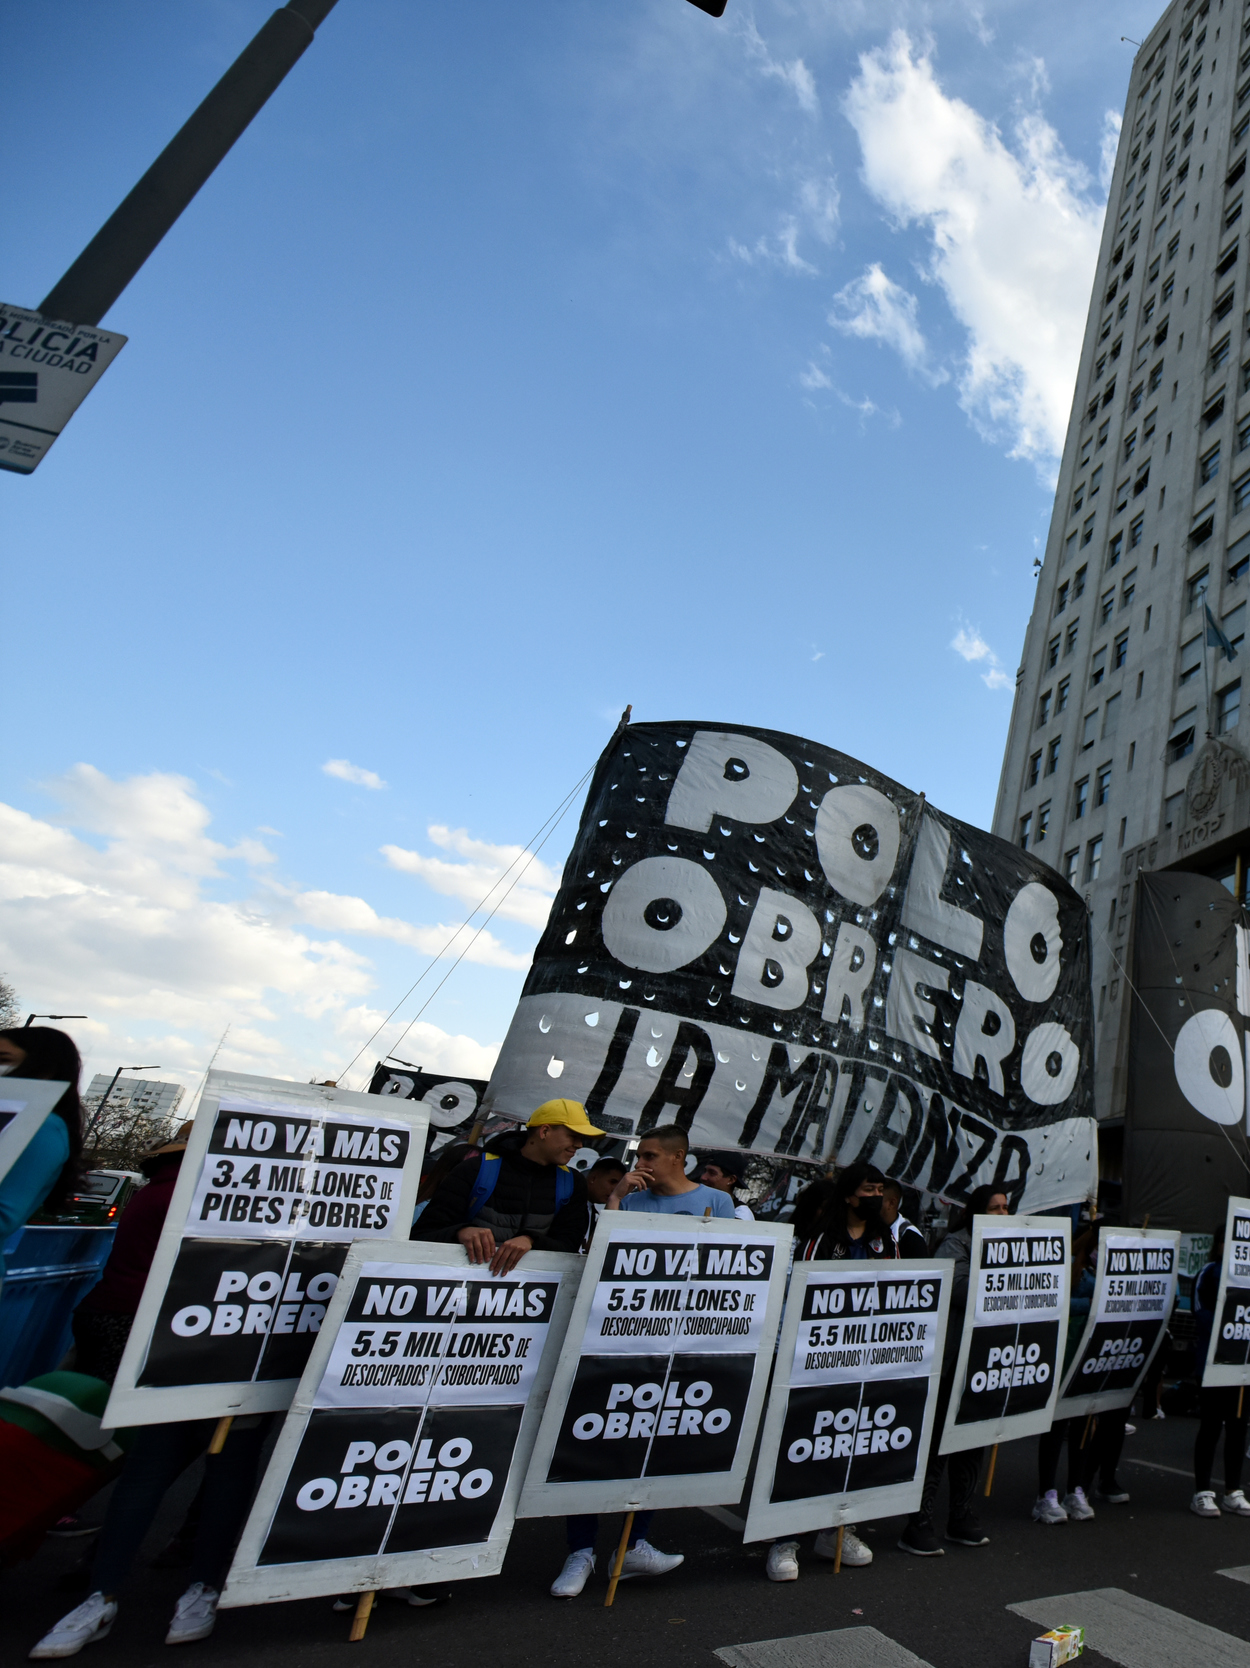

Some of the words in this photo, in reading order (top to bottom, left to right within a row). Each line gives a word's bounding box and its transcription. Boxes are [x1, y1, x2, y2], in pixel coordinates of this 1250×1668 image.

[78, 330, 97, 340] POR
[99, 336, 111, 344] LA
[10, 343, 93, 375] CIUDAD
[664, 731, 1062, 1002] POLO
[601, 856, 1080, 1105] OBRERO
[587, 1007, 716, 1136] LA
[738, 1043, 1030, 1214] MATANZA
[223, 1118, 277, 1152] NO
[285, 1124, 325, 1157] VA
[332, 1126, 401, 1162] MÁS
[211, 1160, 261, 1190] 3.4
[267, 1165, 378, 1200] MILLONES
[380, 1181, 395, 1201] DE
[200, 1192, 284, 1224] PIBES
[288, 1198, 391, 1230] POBRES
[1236, 1220, 1250, 1239] NO
[612, 1248, 657, 1276] NO
[664, 1249, 699, 1276] VA
[705, 1244, 766, 1276] MÁS
[986, 1241, 1009, 1265] NO
[1010, 1241, 1029, 1263] VA
[1032, 1238, 1062, 1262] MÁS
[1110, 1252, 1126, 1272] NO
[1129, 1252, 1144, 1271] VA
[1147, 1250, 1171, 1270] MÁS
[1235, 1245, 1248, 1261] 5.5
[213, 1271, 339, 1302] POLO
[811, 1288, 846, 1315] NO
[851, 1286, 880, 1312] VA
[885, 1279, 935, 1309] MÁS
[985, 1273, 1005, 1292] 5.5
[1007, 1272, 1051, 1291] MILLONES
[1053, 1275, 1059, 1289] DE
[1108, 1280, 1124, 1296] 5.5
[1124, 1280, 1162, 1296] MILLONES
[361, 1284, 418, 1317] NO
[426, 1286, 468, 1317] VA
[474, 1280, 547, 1318] MÁS
[607, 1288, 647, 1311] 5.5
[649, 1289, 742, 1311] MILLONES
[743, 1294, 756, 1311] DE
[170, 1303, 327, 1337] OBRER
[600, 1317, 673, 1336] DESOCUPADOS
[673, 1317, 685, 1336] Y
[683, 1317, 752, 1336] SUBOCUPADOS
[808, 1325, 839, 1347] 5.5
[842, 1321, 915, 1345] MILLONES
[917, 1324, 928, 1340] DE
[351, 1330, 402, 1357] 5.5
[402, 1331, 514, 1358] MILLONES
[515, 1338, 532, 1358] DE
[805, 1350, 862, 1370] DESOCUPADOS
[862, 1348, 871, 1366] Y
[870, 1345, 924, 1365] SUBOCUPADOS
[987, 1343, 1041, 1368] POLO
[1100, 1337, 1142, 1356] POLO
[340, 1364, 429, 1386] DESOCUPADOS
[429, 1364, 444, 1386] Y
[441, 1364, 523, 1386] SUBOCUPADOS
[971, 1362, 1050, 1393] OBRERO
[1082, 1353, 1145, 1374] OBRERO
[606, 1380, 713, 1410] POLO
[572, 1408, 732, 1440] OBRERO
[813, 1404, 896, 1435] POLO
[339, 1437, 473, 1474] POLO
[787, 1426, 913, 1463] OBRERO
[296, 1468, 494, 1511] OBRERO
